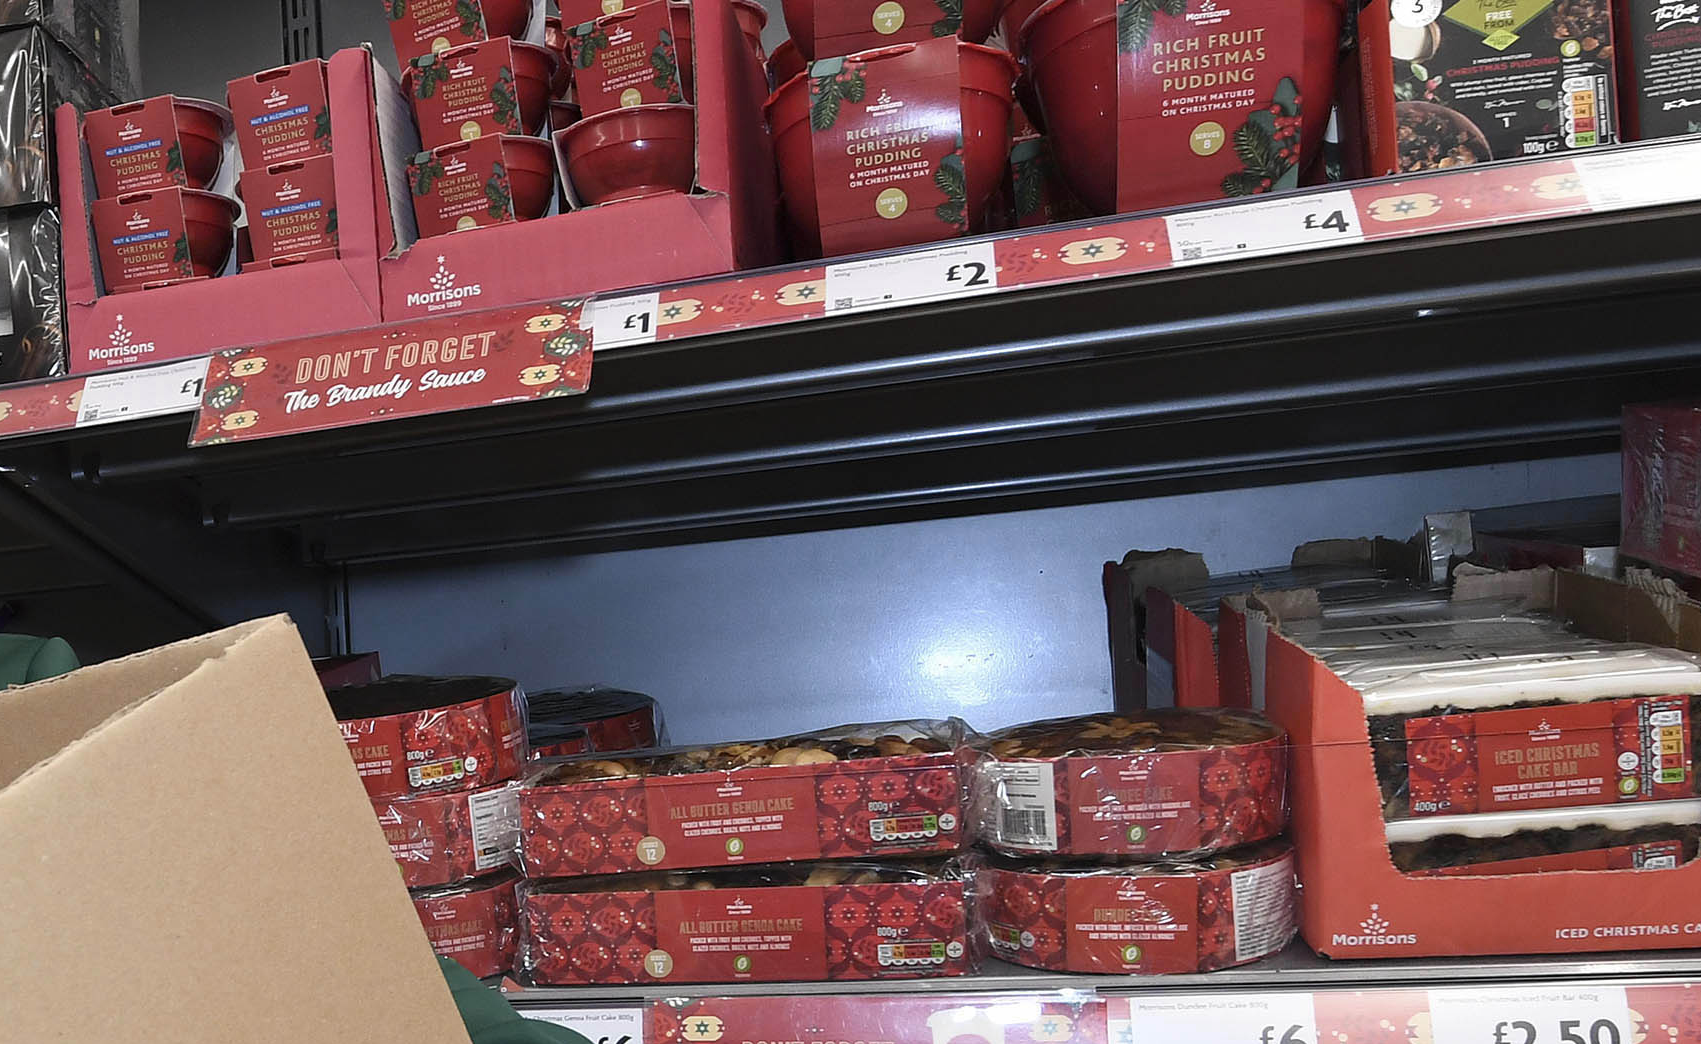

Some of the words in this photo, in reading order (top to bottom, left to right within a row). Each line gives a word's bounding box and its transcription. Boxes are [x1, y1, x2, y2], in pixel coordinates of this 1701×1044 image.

[1485, 10, 1513, 21] FREE
[1152, 37, 1200, 57] RICH
[1208, 27, 1266, 49] FRUIT
[1152, 47, 1266, 75] CHRISTMAS
[1163, 68, 1255, 92] PUDDING
[1161, 108, 1177, 117] ON
[1179, 102, 1233, 115] CHRISTMAS
[1235, 98, 1255, 108] DAY
[1171, 94, 1207, 106] MONTH
[1209, 88, 1255, 101] MATURED
[255, 116, 309, 137] CHRISTMAS
[846, 125, 880, 142] RICH
[846, 131, 929, 156] CHRISTMAS
[110, 150, 162, 168] CHRISTMAS
[855, 147, 922, 168] PUDDING
[116, 161, 158, 177] PUDDING
[1302, 210, 1349, 233] £4
[117, 240, 169, 256] CHRISTMAS
[123, 251, 166, 265] PUDDING
[945, 262, 990, 287] £2
[407, 281, 481, 307] Morrisons
[623, 311, 651, 334] £1
[88, 339, 156, 361] Morrisons
[295, 347, 378, 385] DON'T
[384, 331, 497, 371] FORGET
[284, 388, 319, 414] The
[326, 377, 412, 409] Brandy
[419, 367, 487, 392] Sauce
[1494, 748, 1524, 766] ICED
[1526, 742, 1600, 763] CHRISTMAS
[1517, 762, 1550, 780] CAKE
[1552, 760, 1578, 776] BAR
[1413, 800, 1437, 813] 400g
[1555, 927, 1590, 939] ICED
[1593, 924, 1679, 938] CHRISTMAS
